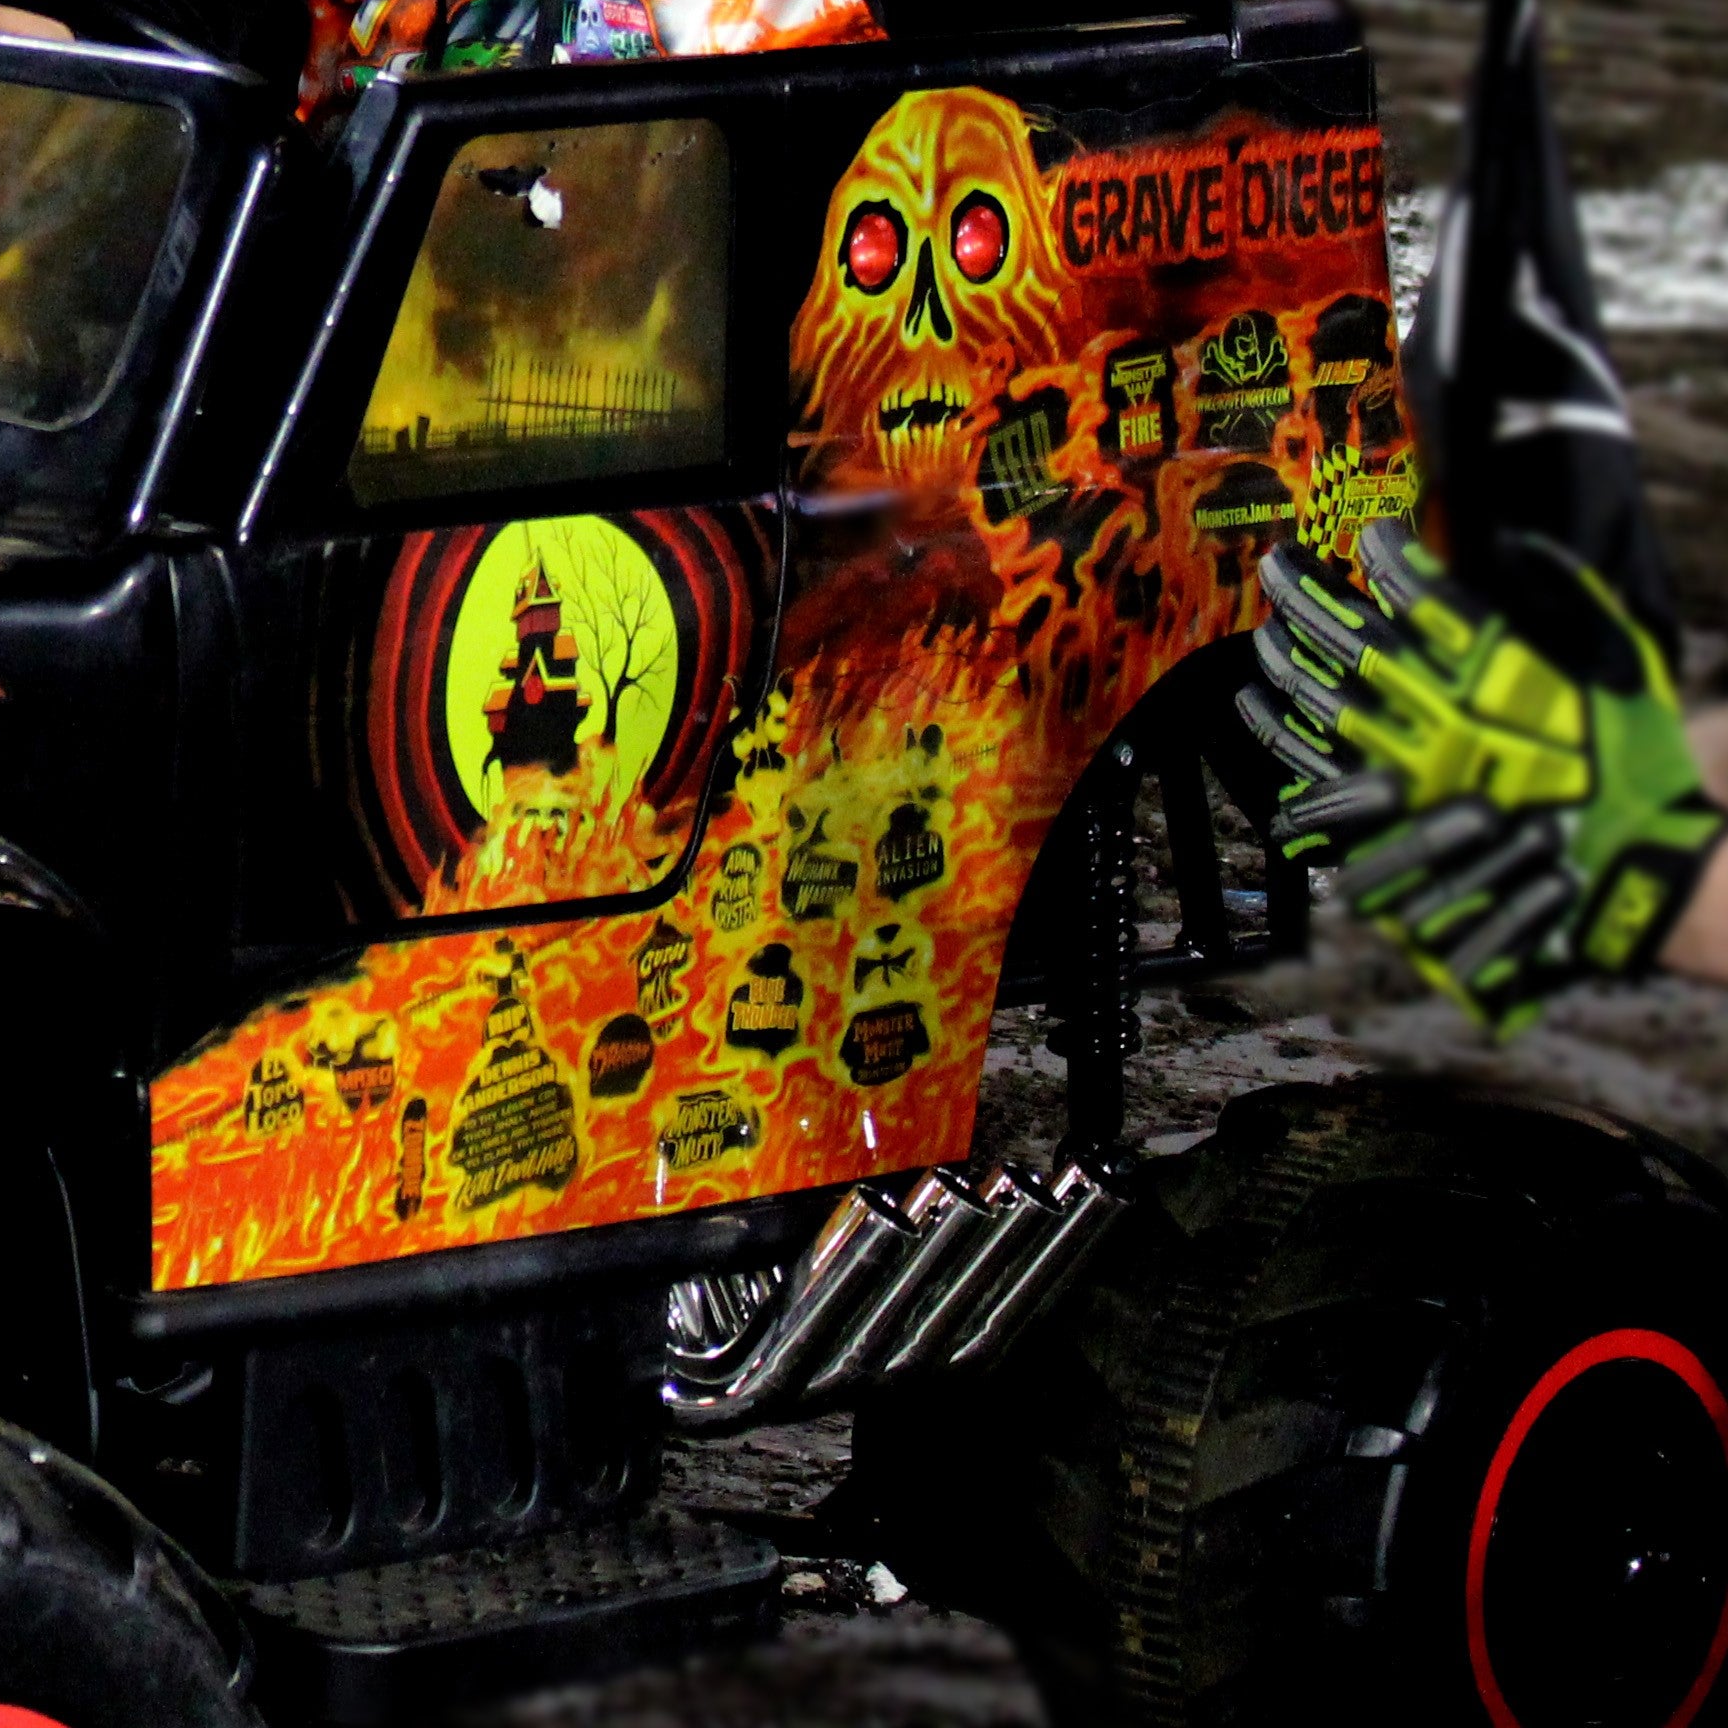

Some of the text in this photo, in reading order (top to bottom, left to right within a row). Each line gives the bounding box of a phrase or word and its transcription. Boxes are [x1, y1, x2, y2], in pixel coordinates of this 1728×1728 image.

[1063, 164, 1226, 268] GRAVE
[1119, 411, 1163, 450] FIRE
[1345, 495, 1404, 516] HOT ROD
[878, 832, 939, 865] ALIEN
[462, 1063, 556, 1111] ANDERSON
[479, 1048, 541, 1088] DENNIS
